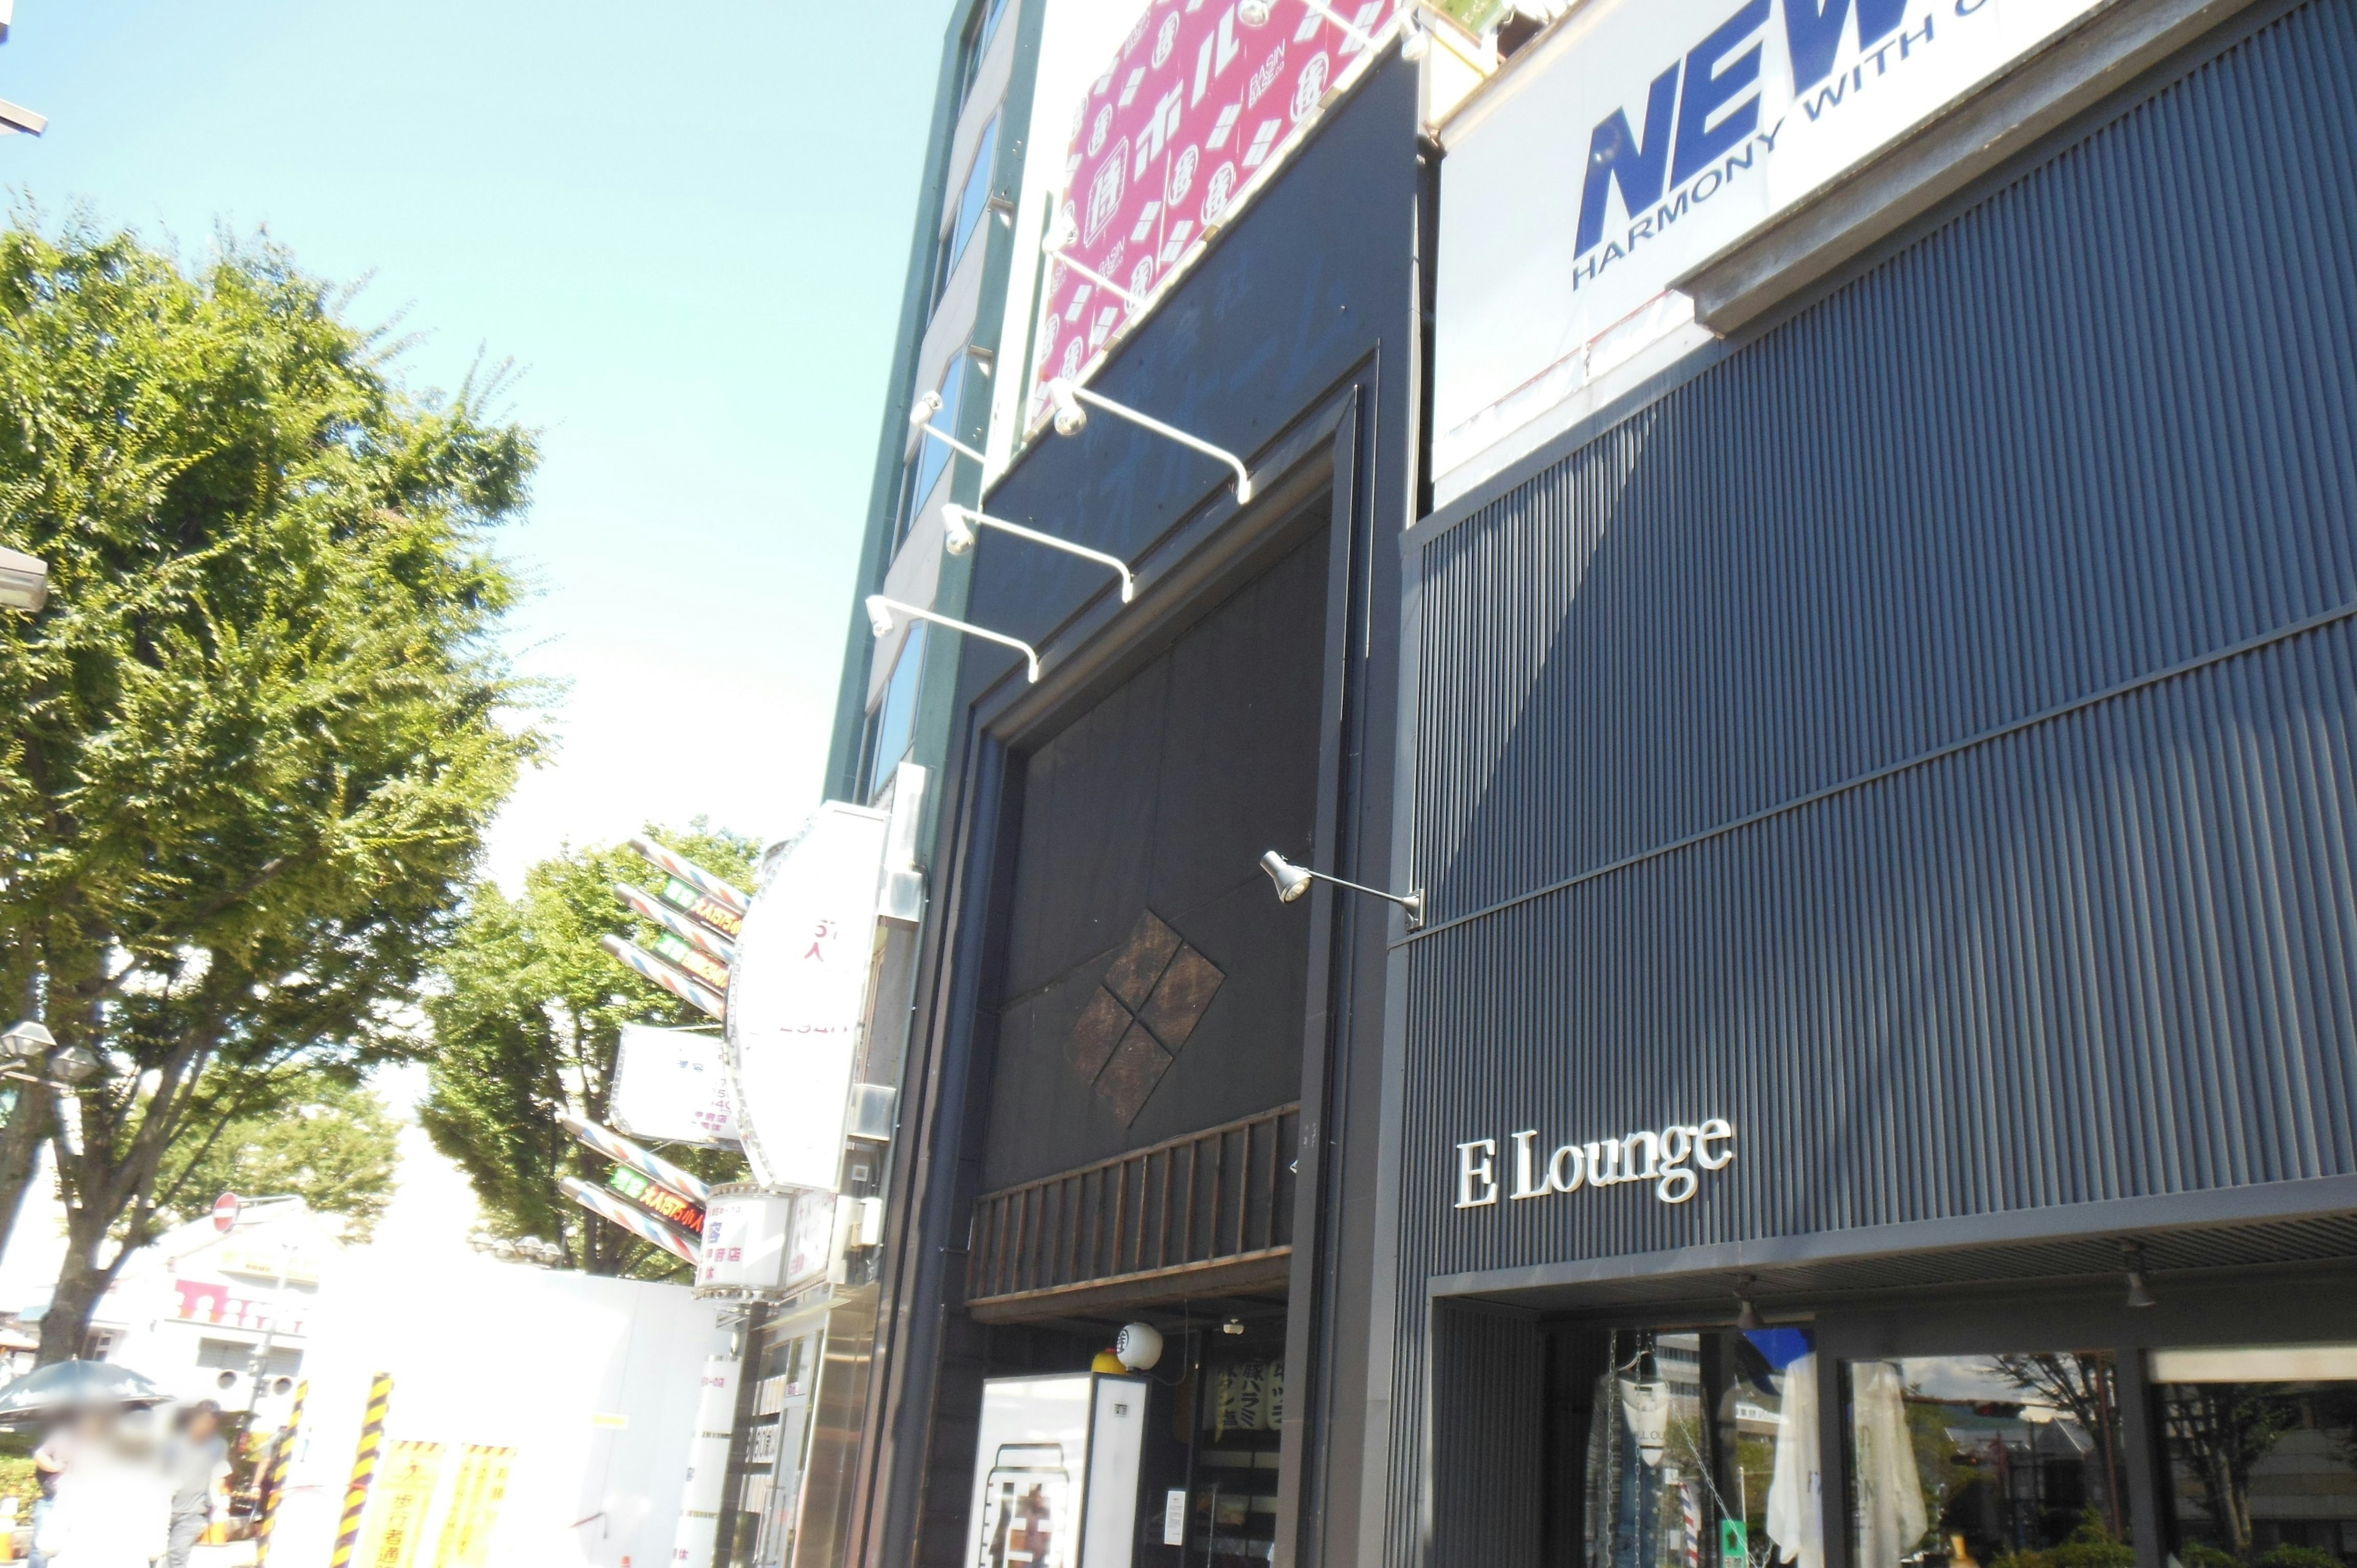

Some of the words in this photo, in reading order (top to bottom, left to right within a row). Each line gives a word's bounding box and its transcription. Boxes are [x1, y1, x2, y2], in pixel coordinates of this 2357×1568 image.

[1248, 61, 1285, 109] BASE.CO
[1250, 38, 1285, 91] BASIN
[1573, 115, 1786, 292] HARMONY
[1802, 14, 1935, 122] WITH
[1455, 1138, 1498, 1209] E
[1509, 1118, 1733, 1204] Lounge
[375, 1494, 413, 1568] 歩行者通
